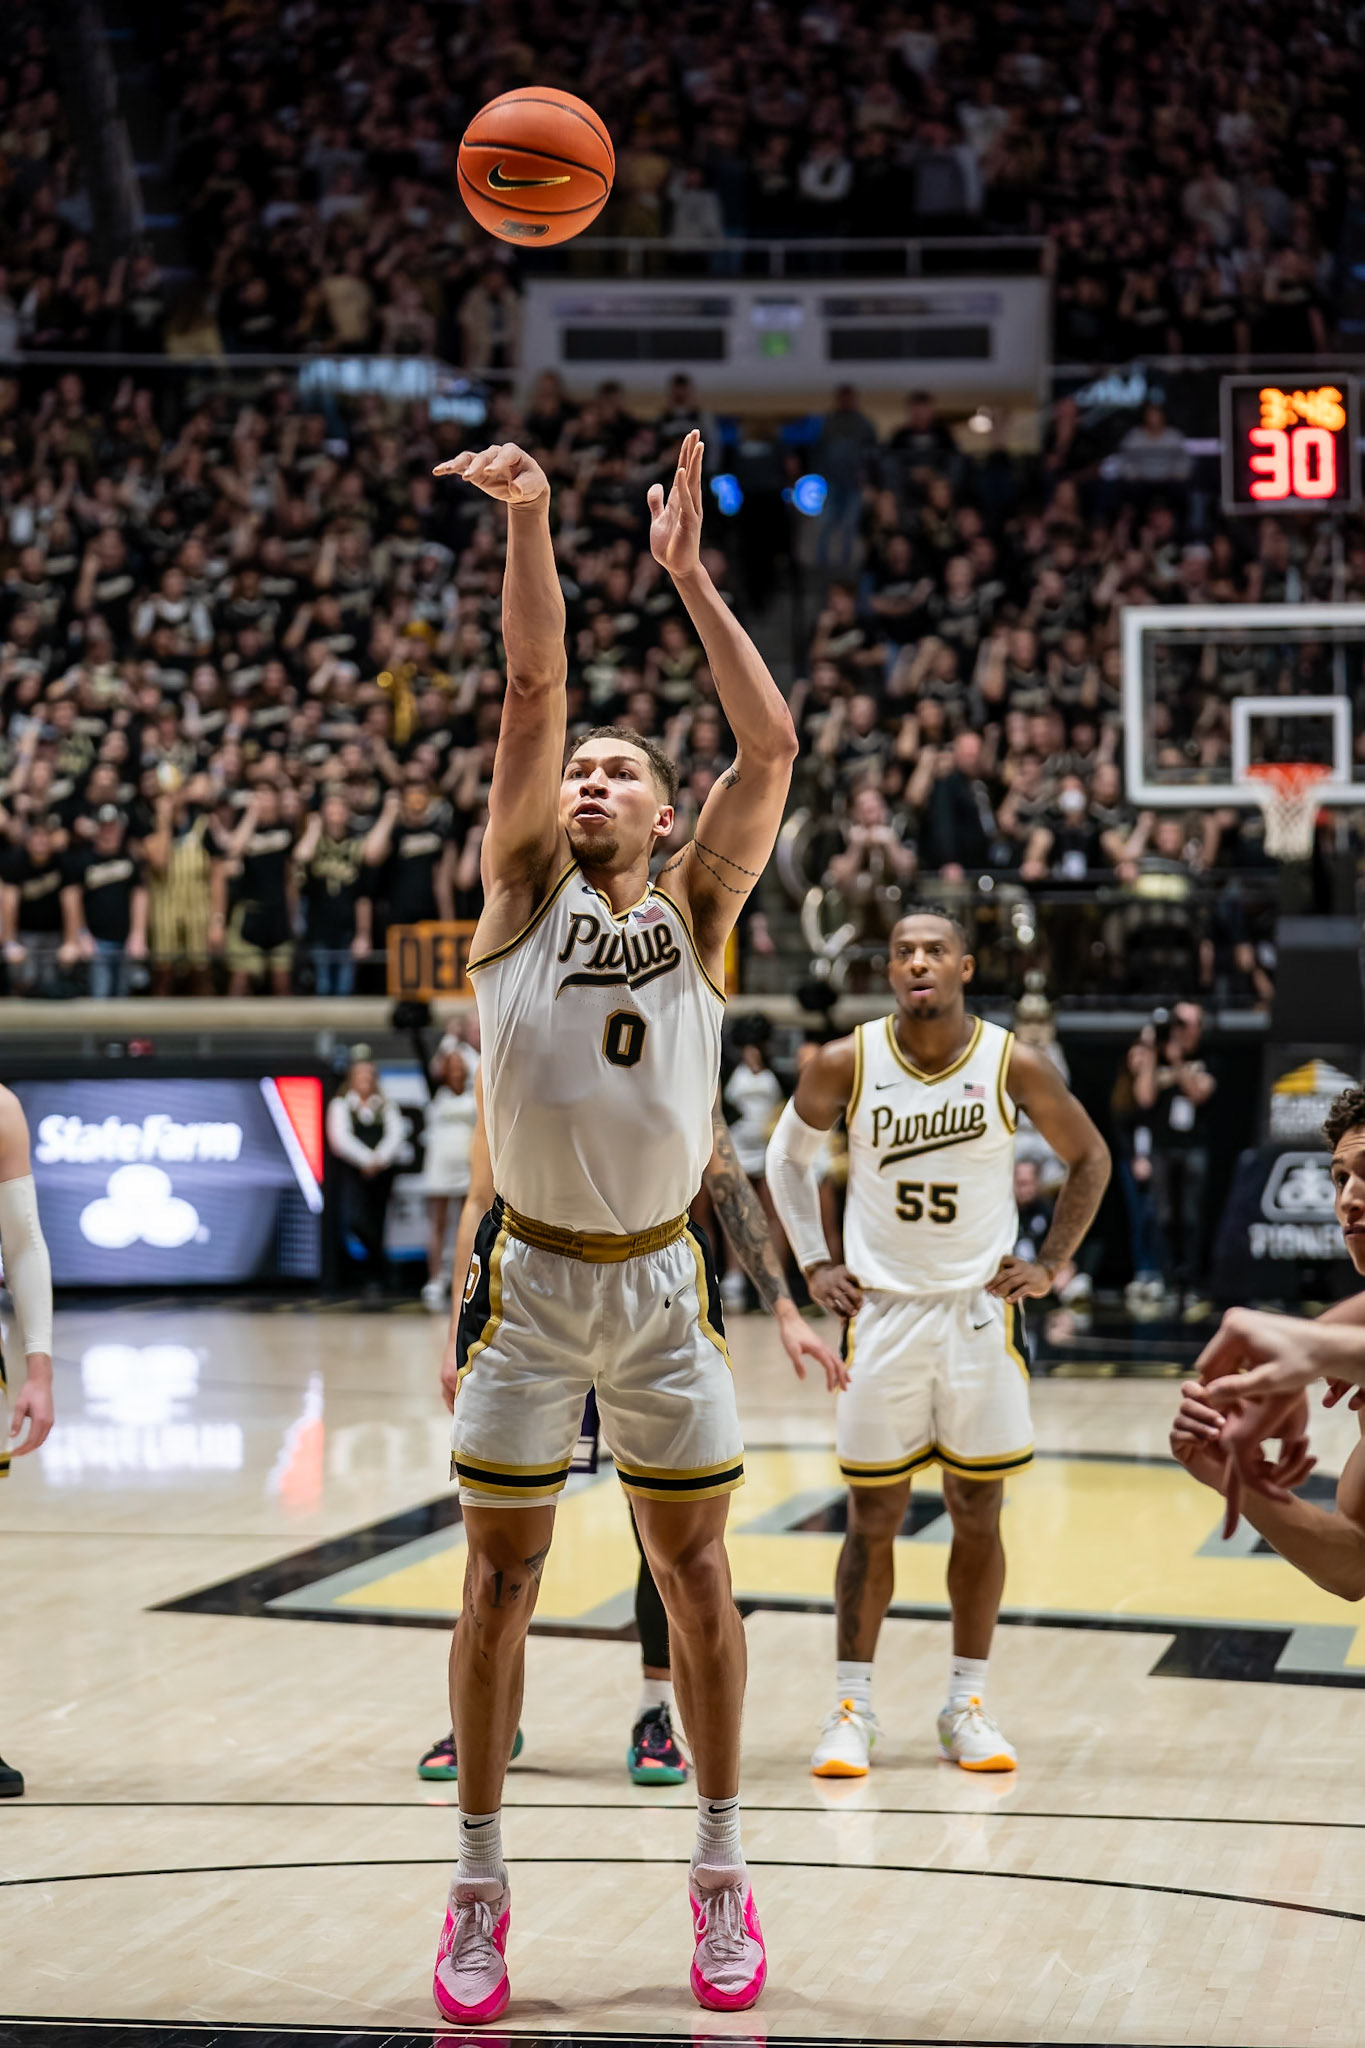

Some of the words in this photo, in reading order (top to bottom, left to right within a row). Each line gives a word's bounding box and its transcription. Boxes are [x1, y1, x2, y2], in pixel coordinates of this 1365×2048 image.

[1260, 386, 1345, 431] 3:46
[1249, 427, 1336, 500] 30
[602, 1008, 647, 1068] 0
[872, 1098, 987, 1160] Purdue
[895, 1180, 958, 1224] 55
